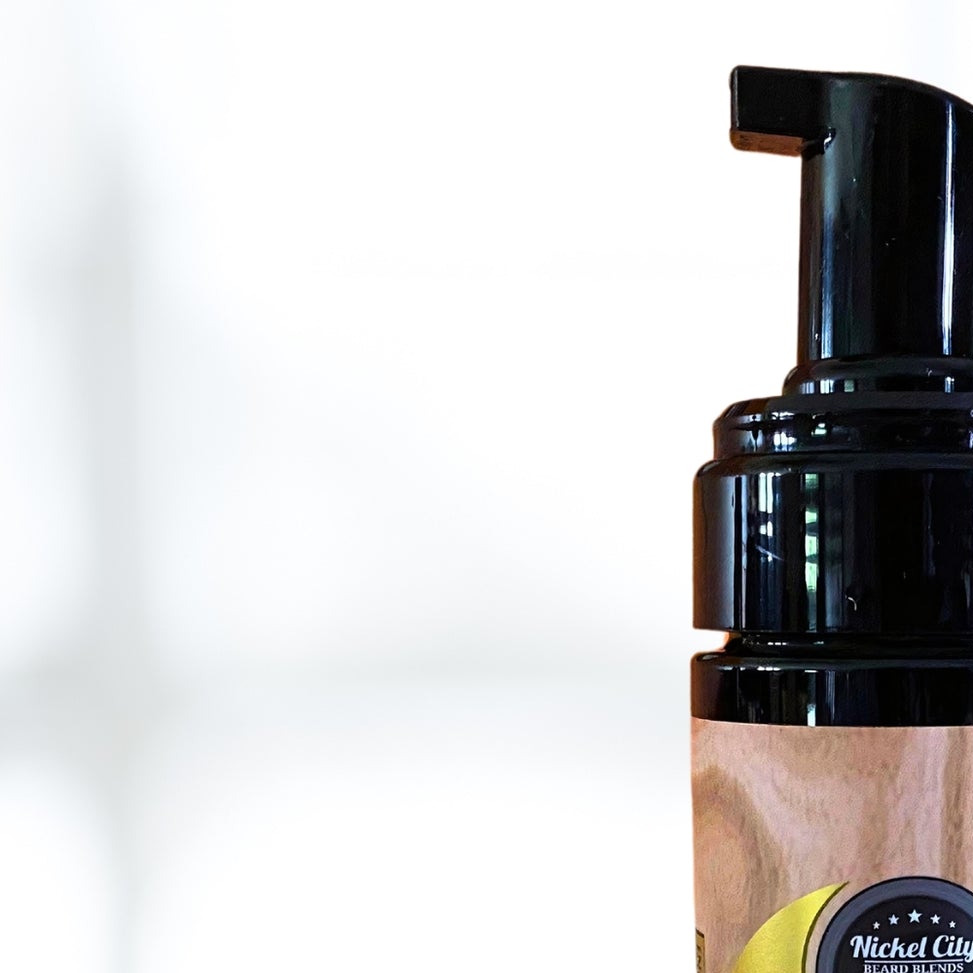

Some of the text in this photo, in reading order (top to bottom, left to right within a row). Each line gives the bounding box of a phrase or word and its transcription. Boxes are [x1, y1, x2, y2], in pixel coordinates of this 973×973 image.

[850, 935, 927, 958] Nickel
[863, 963, 964, 973] BEARD BLENDS
